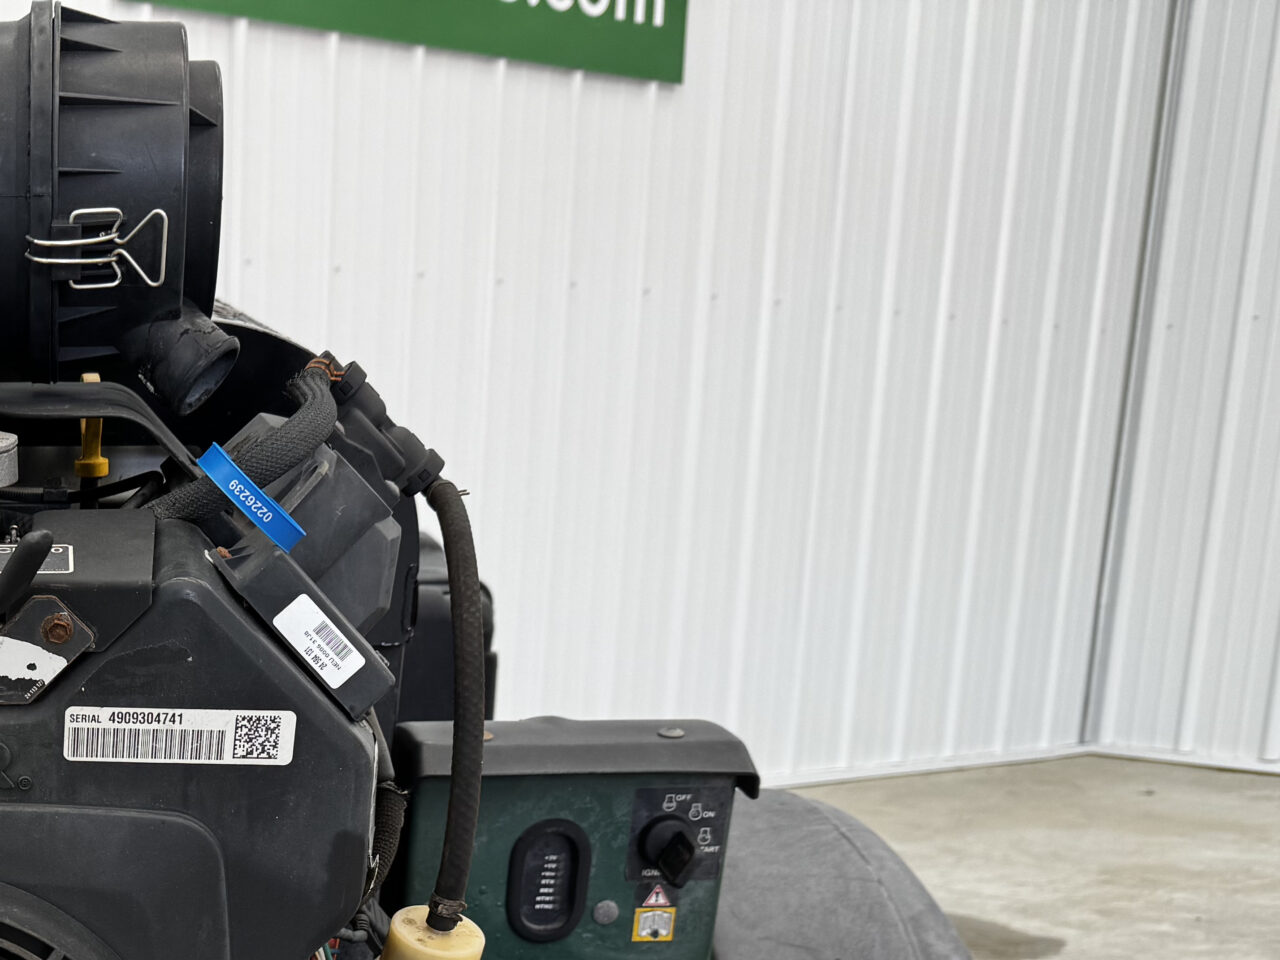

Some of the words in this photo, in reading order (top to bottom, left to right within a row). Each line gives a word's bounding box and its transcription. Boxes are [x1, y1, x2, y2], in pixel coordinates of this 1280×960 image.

[227, 478, 274, 524] 0226239
[69, 713, 102, 724] SERIAL
[108, 711, 183, 726] 4909304741
